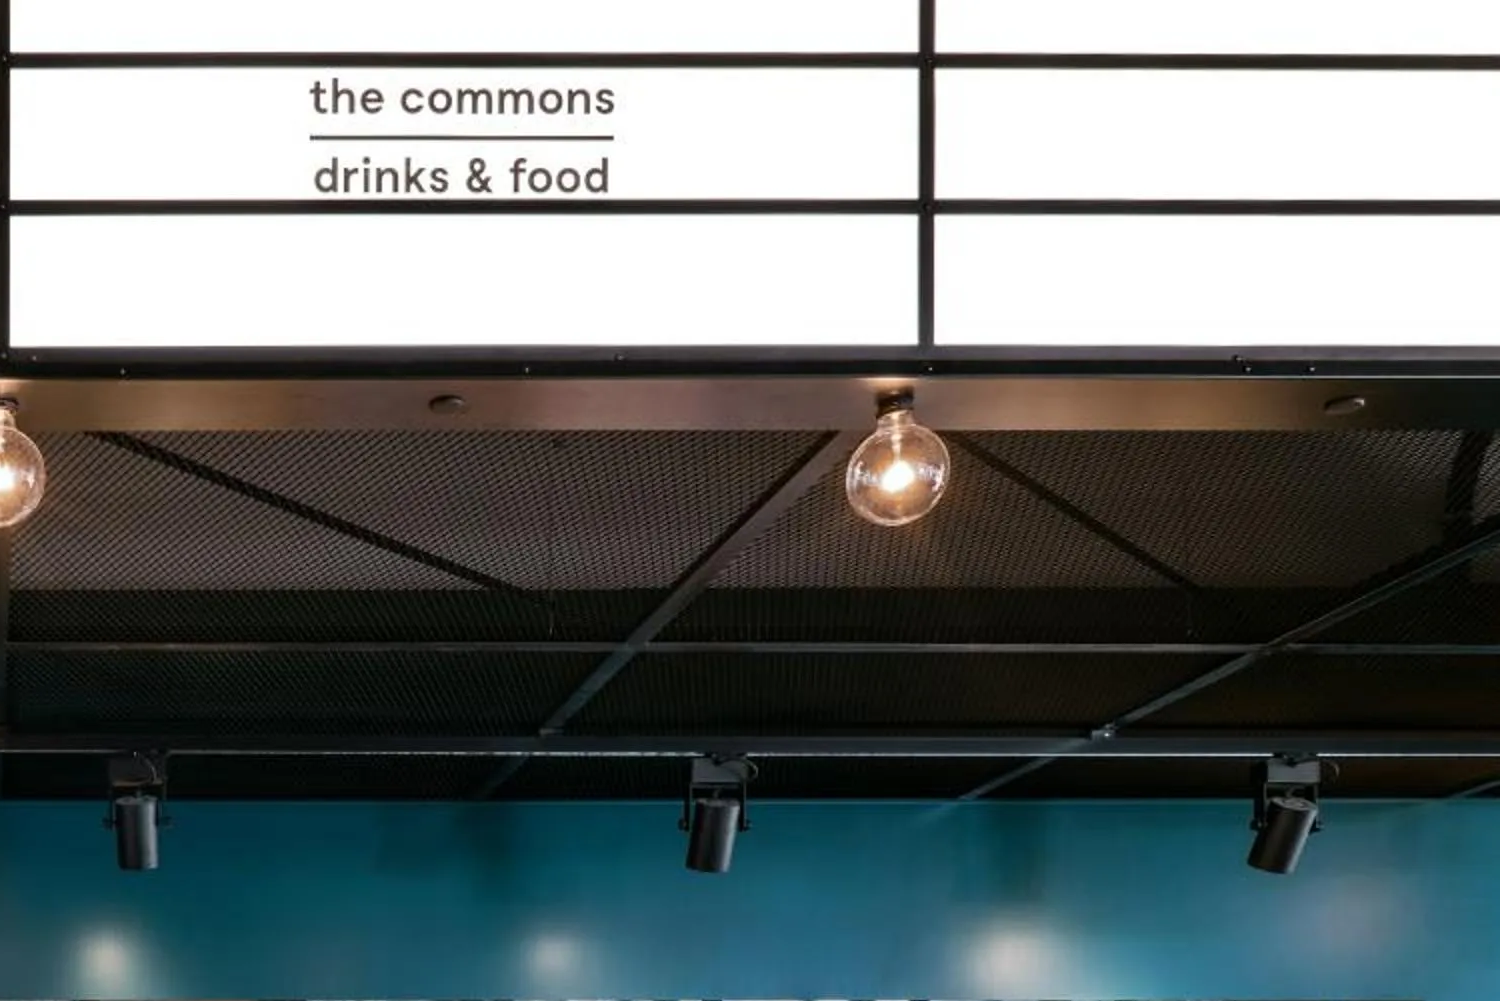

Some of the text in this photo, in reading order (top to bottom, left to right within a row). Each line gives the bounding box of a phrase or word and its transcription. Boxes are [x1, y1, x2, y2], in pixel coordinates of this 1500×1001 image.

[309, 77, 615, 115] the commons
[314, 156, 609, 193] drinks & food
